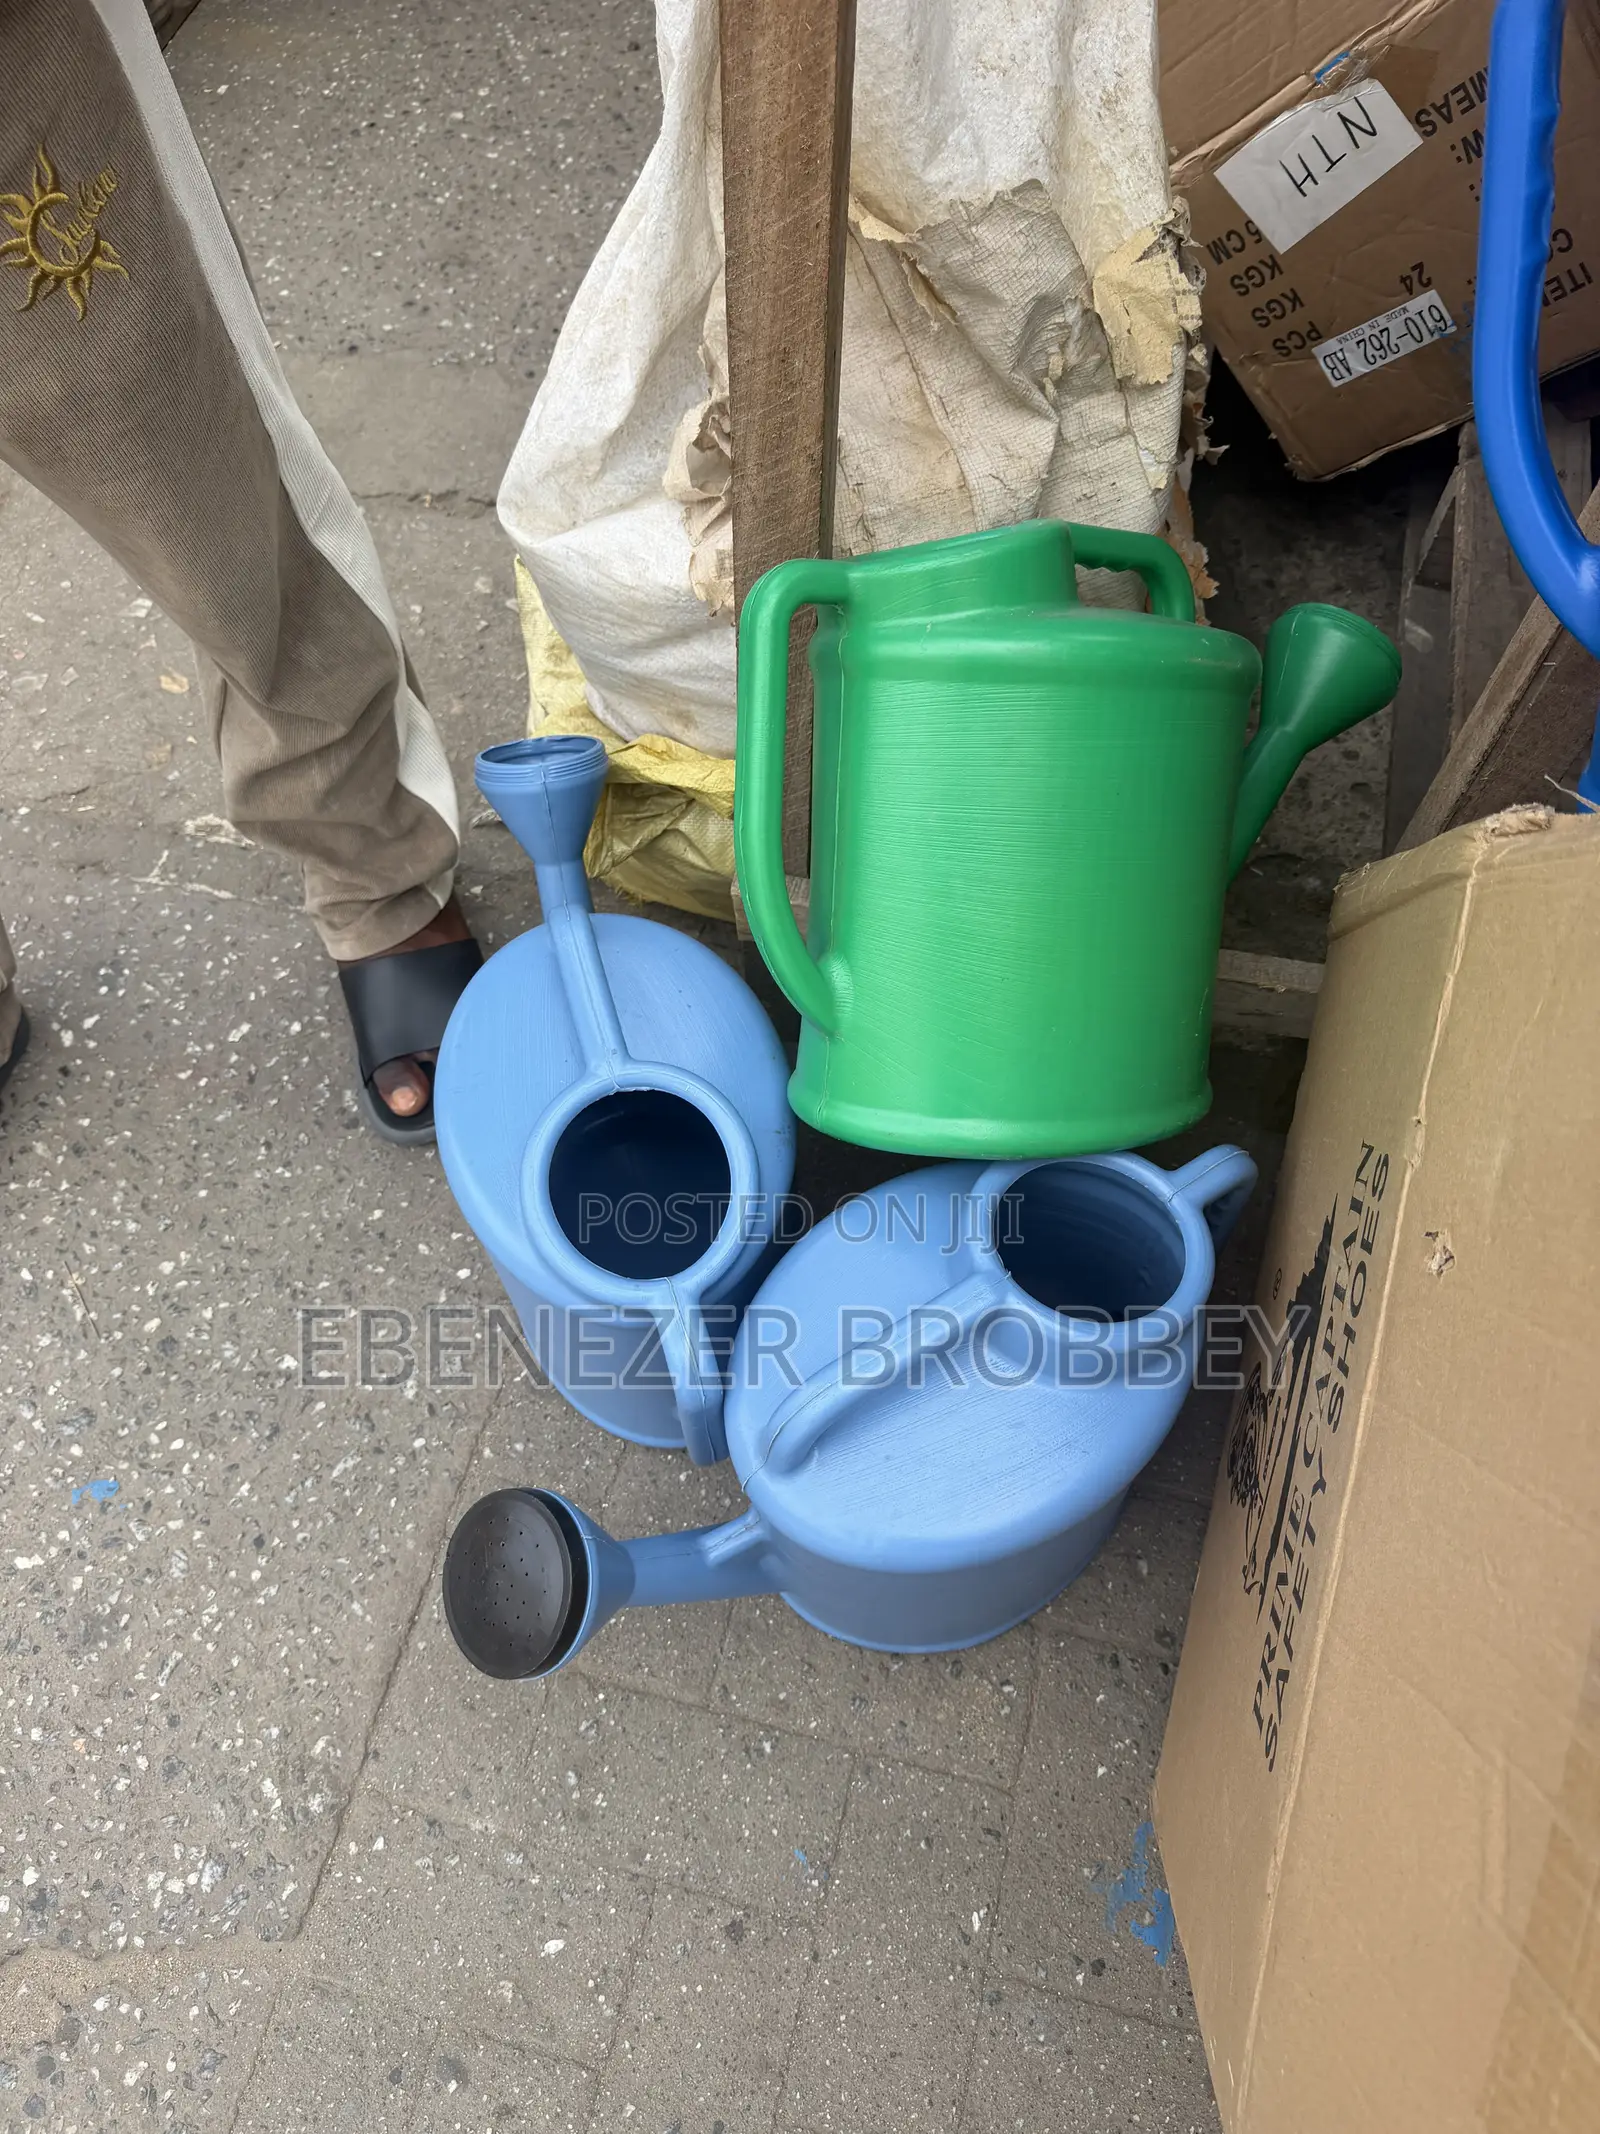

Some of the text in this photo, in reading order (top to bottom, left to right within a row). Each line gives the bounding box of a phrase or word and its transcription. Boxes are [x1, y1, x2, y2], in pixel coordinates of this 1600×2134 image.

[1206, 229, 1246, 266] CM
[1230, 253, 1284, 297] KGS
[1251, 287, 1305, 328] KGS
[1272, 261, 1433, 357] 24 PCS
[1336, 305, 1410, 345] MADE IN CHINA
[1322, 304, 1448, 382] 610-262 AB
[1253, 1138, 1375, 1740] PRIME CAPTAIN
[1264, 1152, 1390, 1773] SAFETY SHOES
